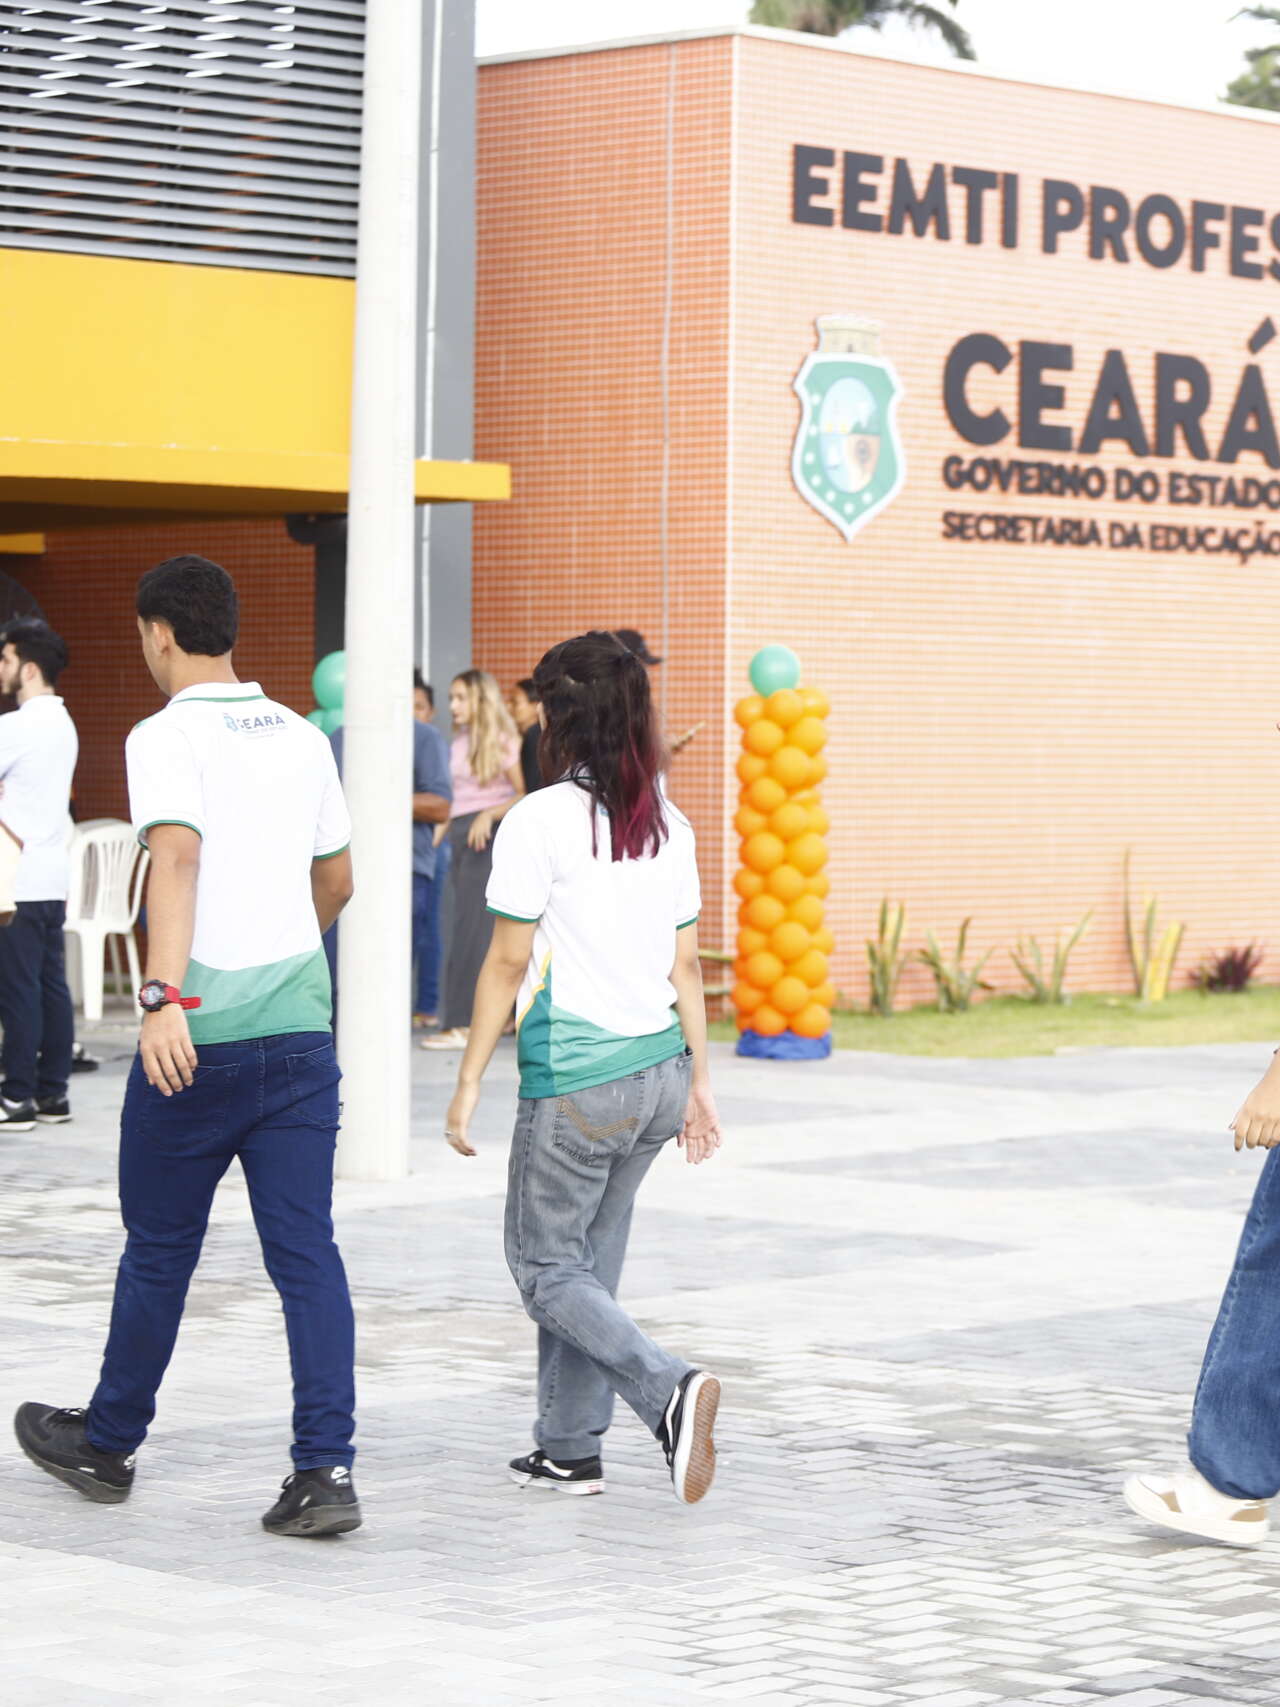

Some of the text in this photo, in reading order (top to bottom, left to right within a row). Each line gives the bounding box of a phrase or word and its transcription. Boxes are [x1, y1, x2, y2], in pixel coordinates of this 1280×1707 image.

[791, 143, 1019, 249] EEMTI
[941, 455, 1107, 499] GOVERNO
[1113, 468, 1161, 503] DO
[941, 510, 1102, 547] SECRETARIA
[1108, 521, 1145, 549] DA
